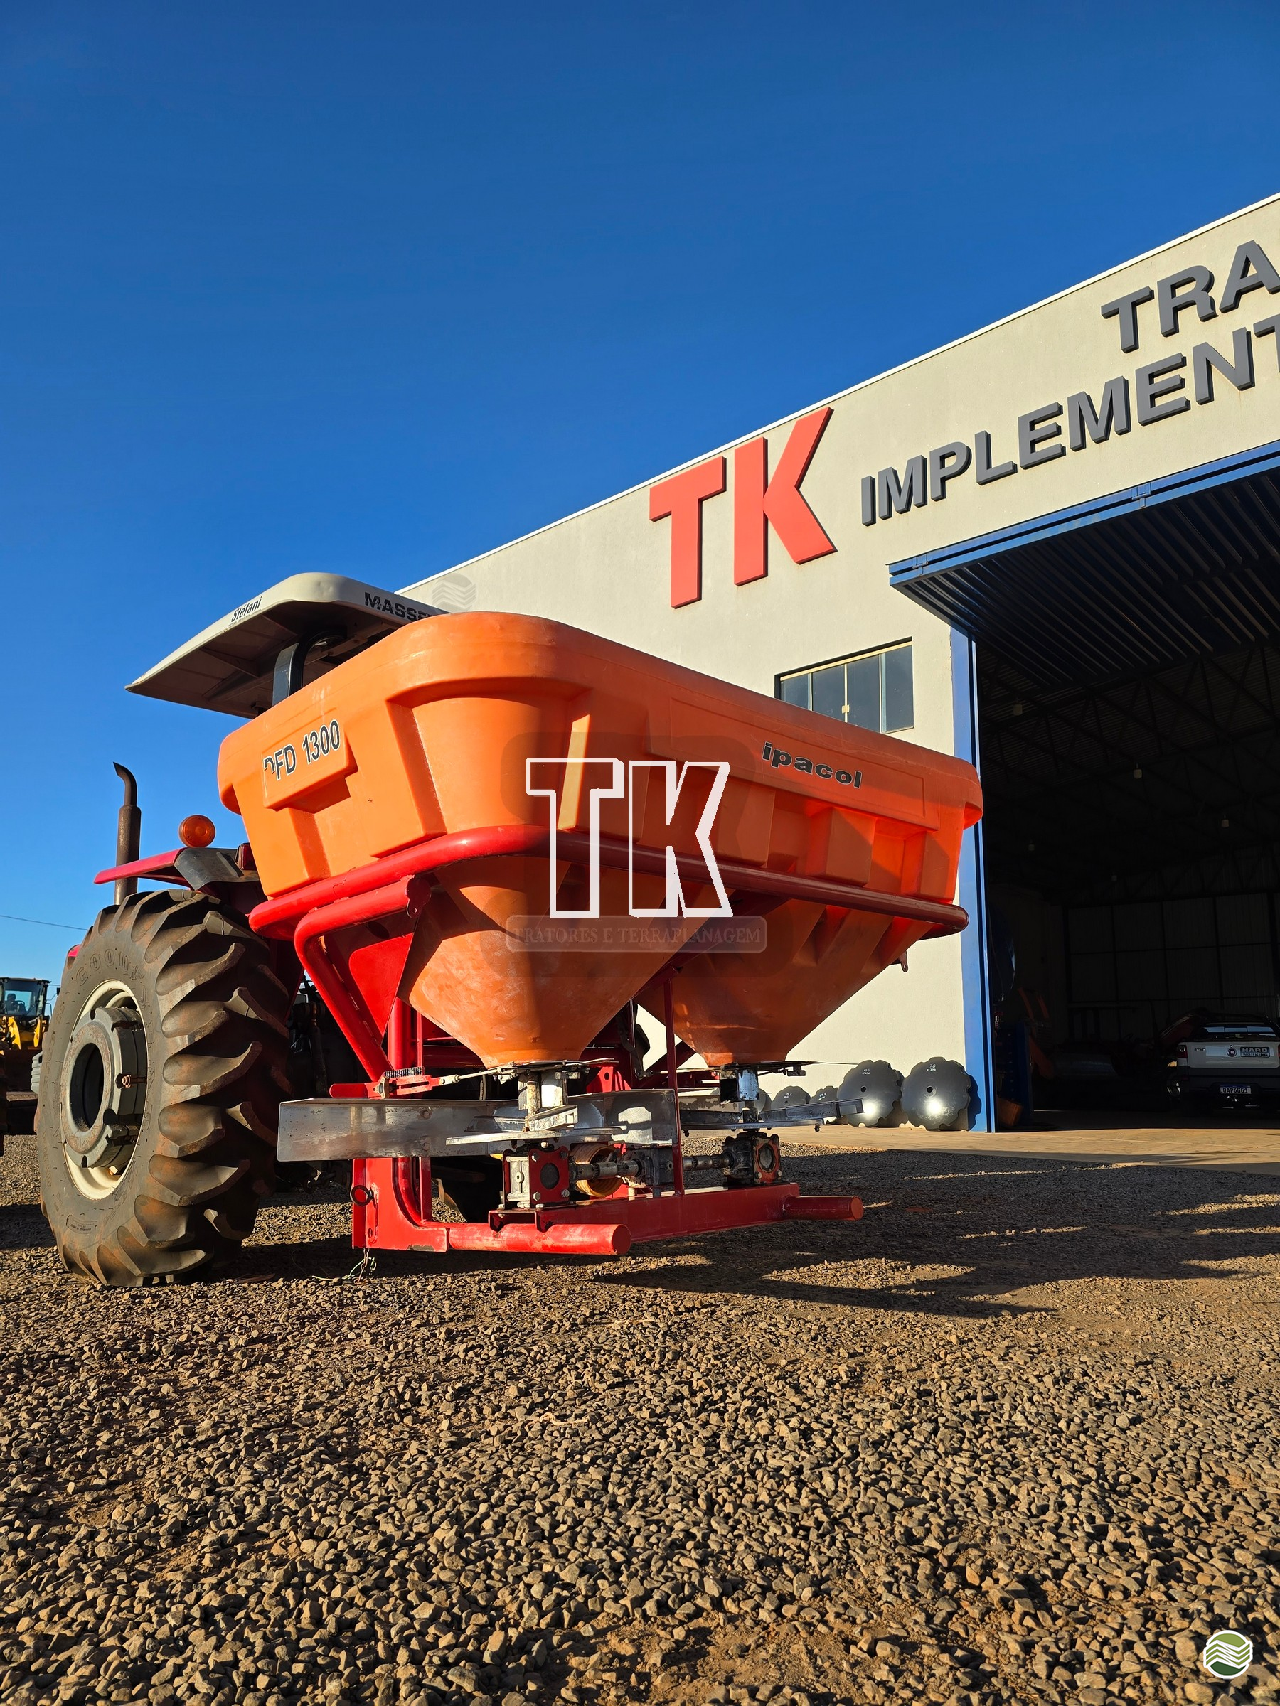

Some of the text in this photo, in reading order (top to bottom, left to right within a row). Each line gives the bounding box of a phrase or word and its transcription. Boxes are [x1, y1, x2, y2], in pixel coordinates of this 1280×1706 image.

[1101, 240, 1280, 354] TRA
[650, 407, 837, 608] TK
[364, 591, 431, 621] MASSE
[302, 719, 341, 765] 1300
[762, 741, 862, 789] ipacol
